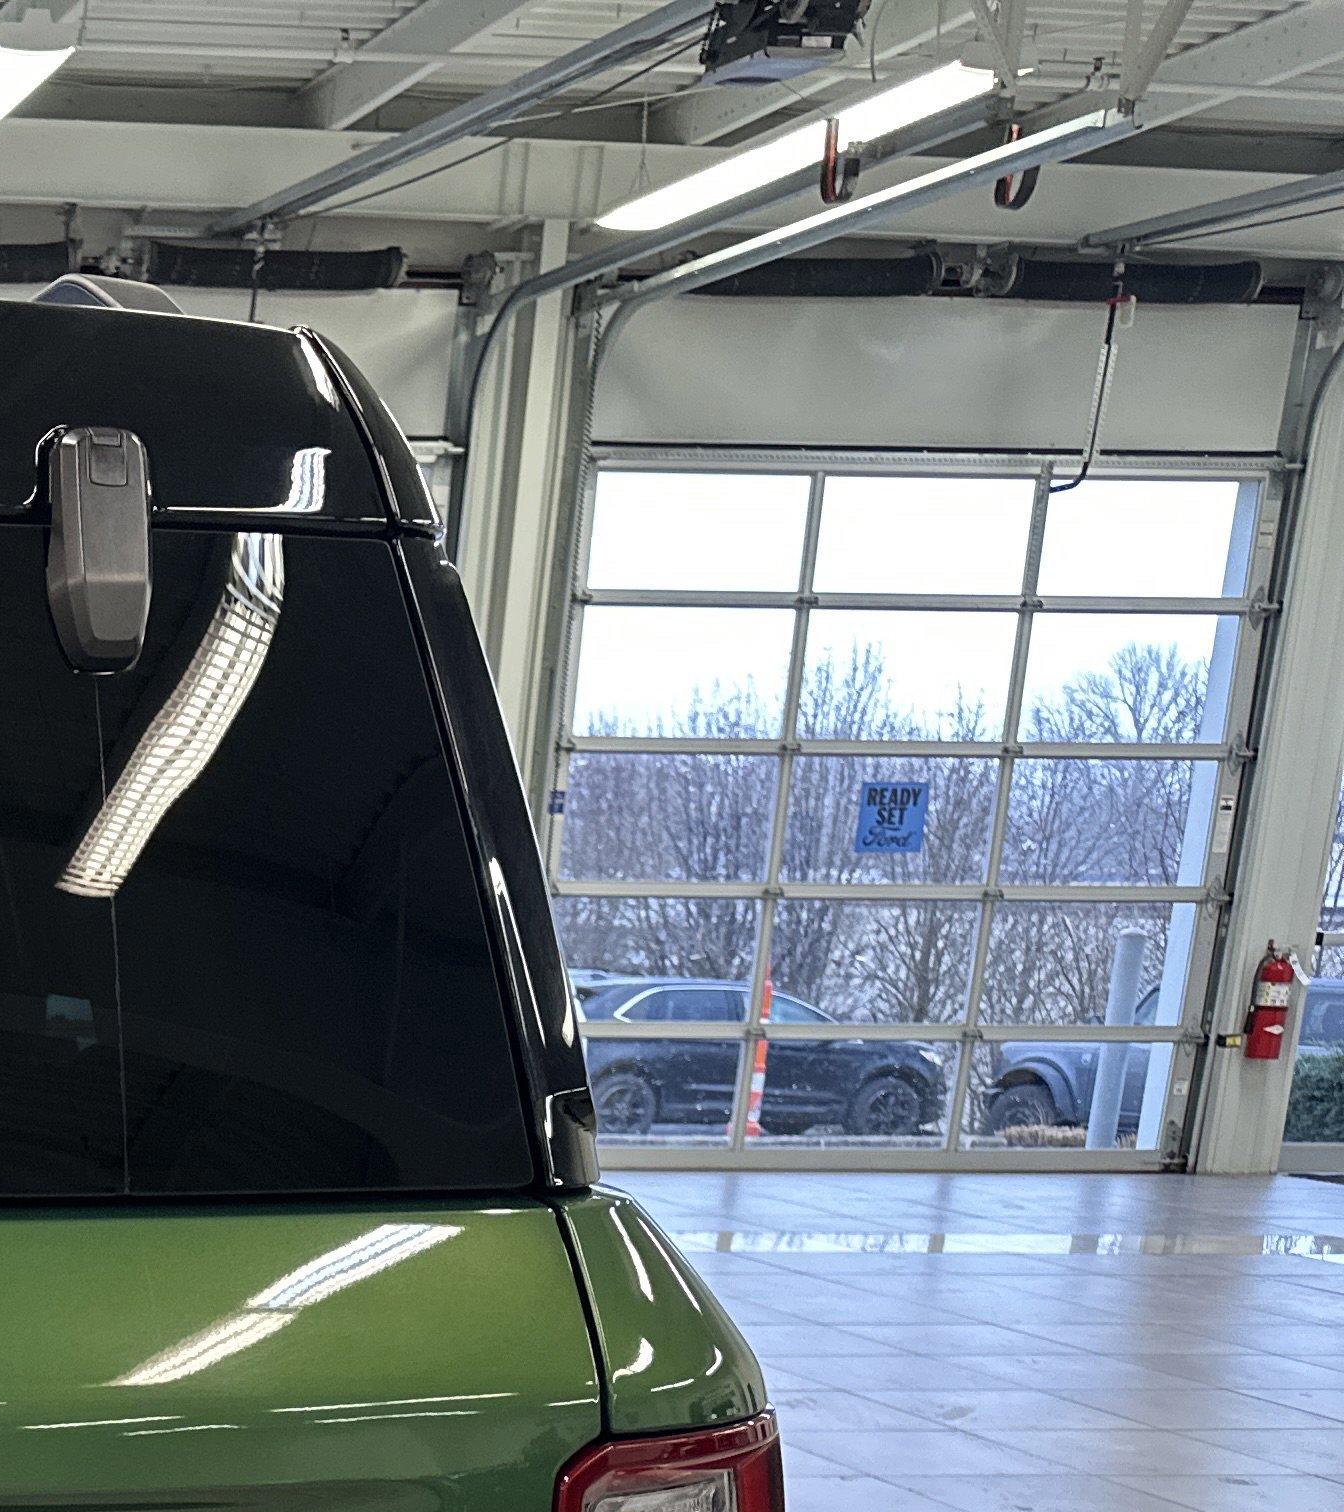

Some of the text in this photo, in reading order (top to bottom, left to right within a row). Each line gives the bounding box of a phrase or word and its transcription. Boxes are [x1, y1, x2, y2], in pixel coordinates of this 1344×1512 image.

[867, 787, 922, 806] READY
[875, 806, 908, 826] SET
[862, 826, 916, 847] Ford
